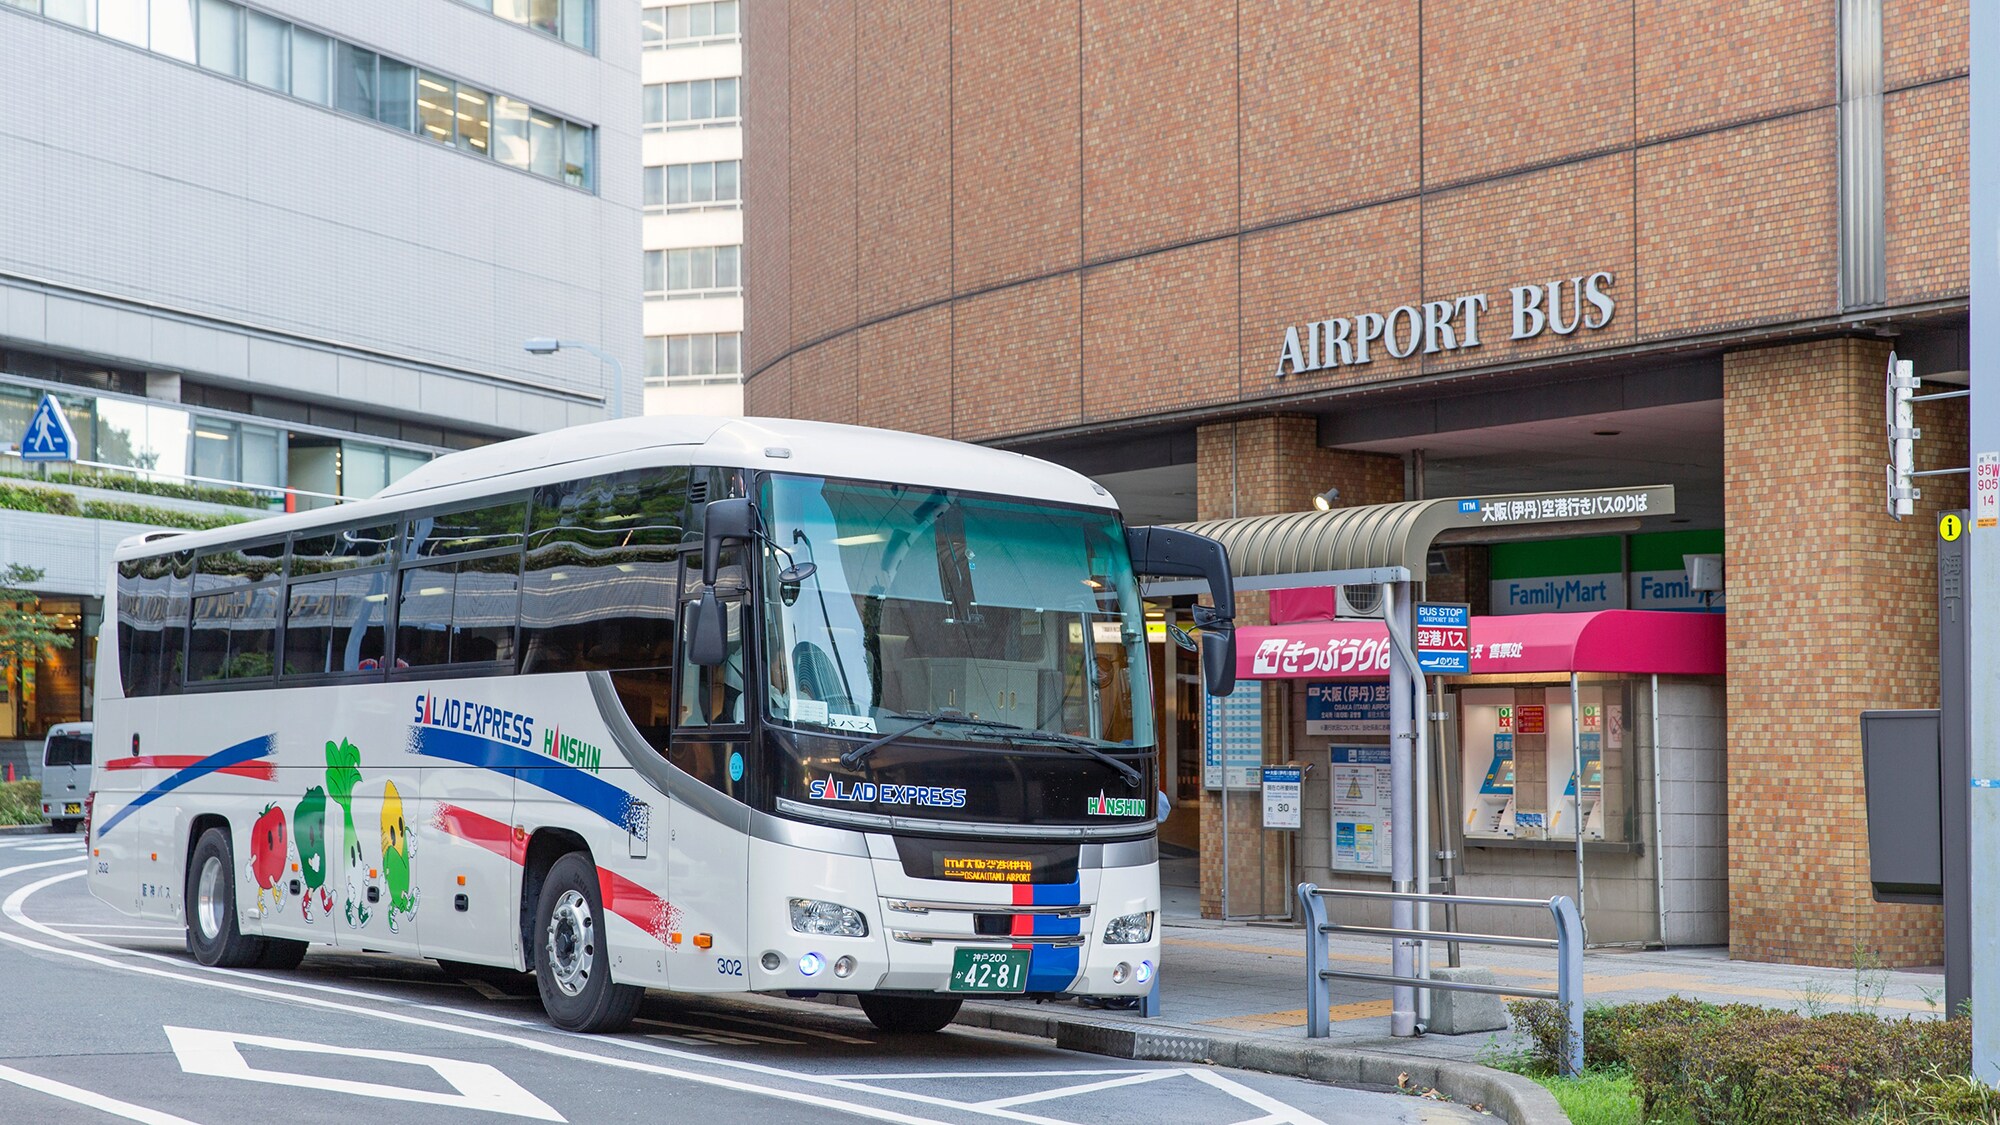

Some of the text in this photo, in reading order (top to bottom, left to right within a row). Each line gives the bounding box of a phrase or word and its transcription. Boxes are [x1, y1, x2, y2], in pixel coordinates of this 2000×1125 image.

[1275, 271, 1616, 377] AIRPORT BUS
[1977, 479, 1998, 491] 905
[1462, 502, 1476, 511] ITM
[1481, 493, 1648, 523] 大阪(伊丹)空港行きバスのりば
[1983, 495, 1995, 506] 14
[1510, 580, 1606, 609] FamilyMart
[1419, 607, 1463, 616] BUS STOP
[1418, 630, 1466, 647] 空港バス
[1440, 657, 1460, 666] のりば
[414, 688, 534, 747] SALAD EXPRESS
[543, 723, 601, 774] HANSHIN
[809, 772, 966, 808] SALAD EXPRESS
[1087, 788, 1146, 817] HANSHIN
[1277, 803, 1290, 812] 30
[98, 862, 109, 874] 302
[1006, 873, 1031, 882] AIRPORT
[717, 957, 743, 976] 302
[964, 963, 1020, 988] 42-81
